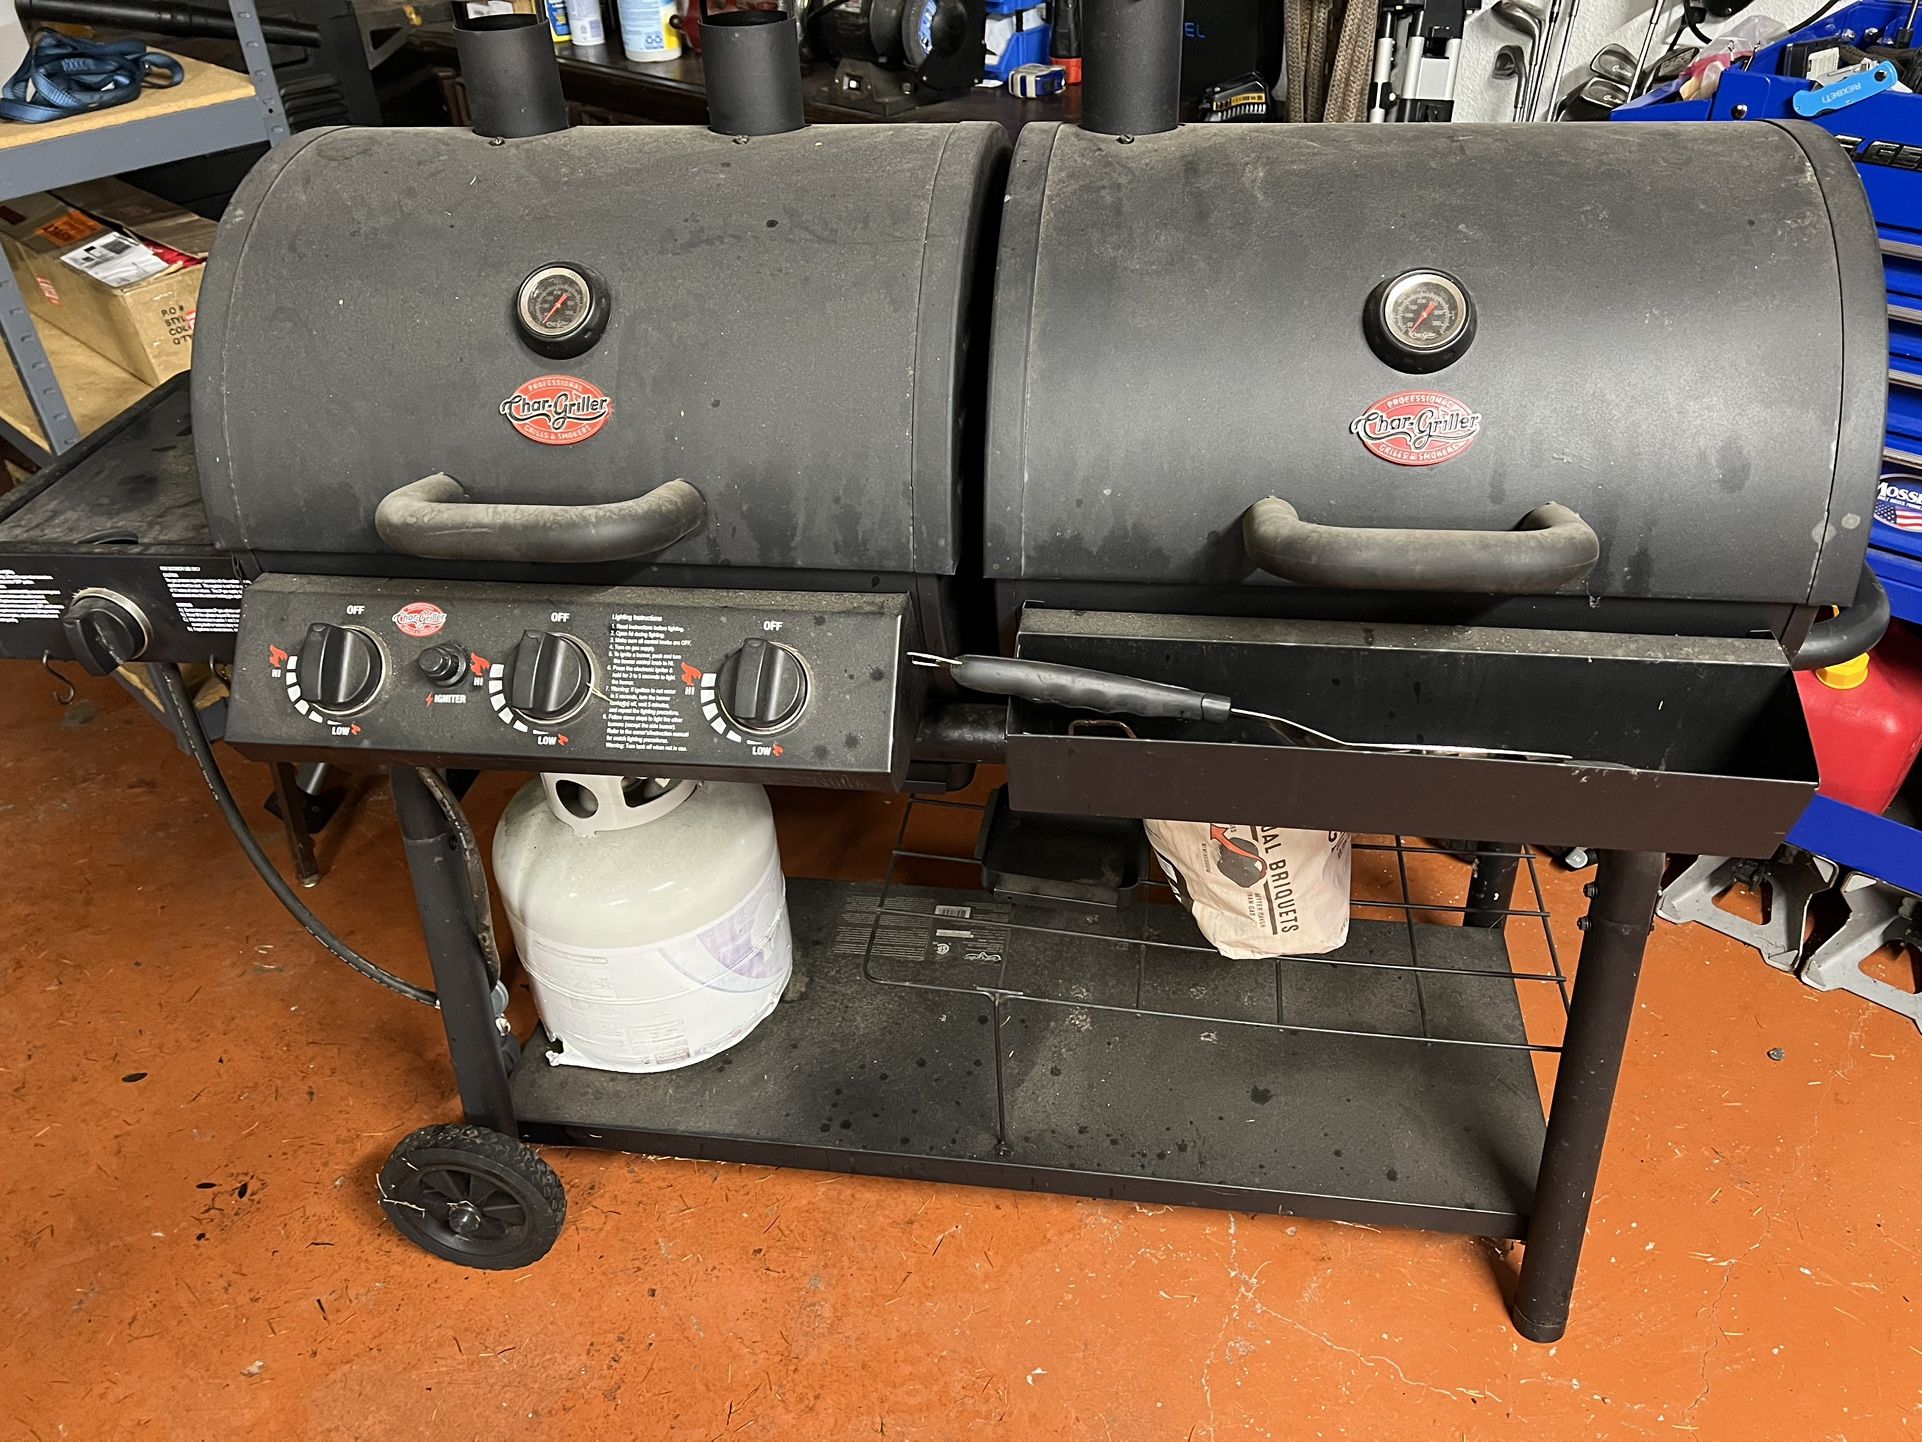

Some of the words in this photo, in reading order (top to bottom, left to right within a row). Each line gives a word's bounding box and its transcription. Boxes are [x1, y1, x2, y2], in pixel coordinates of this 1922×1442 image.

[1821, 83, 1861, 103] REXBETI
[528, 380, 583, 391] PROFESSIONAL
[1387, 394, 1451, 408] PROFESSIONAL
[499, 391, 610, 432] Char-Griller
[524, 424, 550, 439] GRILLS
[557, 425, 592, 440] SMOKERS
[1350, 409, 1482, 452] Char-Griller
[1379, 442, 1408, 458] GRILLS
[1418, 442, 1461, 460] SMOKERS
[347, 605, 365, 615] OFF
[392, 609, 447, 629] Char-Griller
[551, 612, 570, 622] OFF
[763, 621, 783, 631] OFF
[272, 669, 281, 677] HI
[474, 677, 483, 686] HI
[685, 687, 695, 695] HI
[434, 695, 466, 703] IGNITER
[332, 727, 350, 736] LOW
[538, 736, 557, 745] LOW
[752, 746, 771, 755] LOW
[1269, 859, 1299, 933] BRIQUETS
